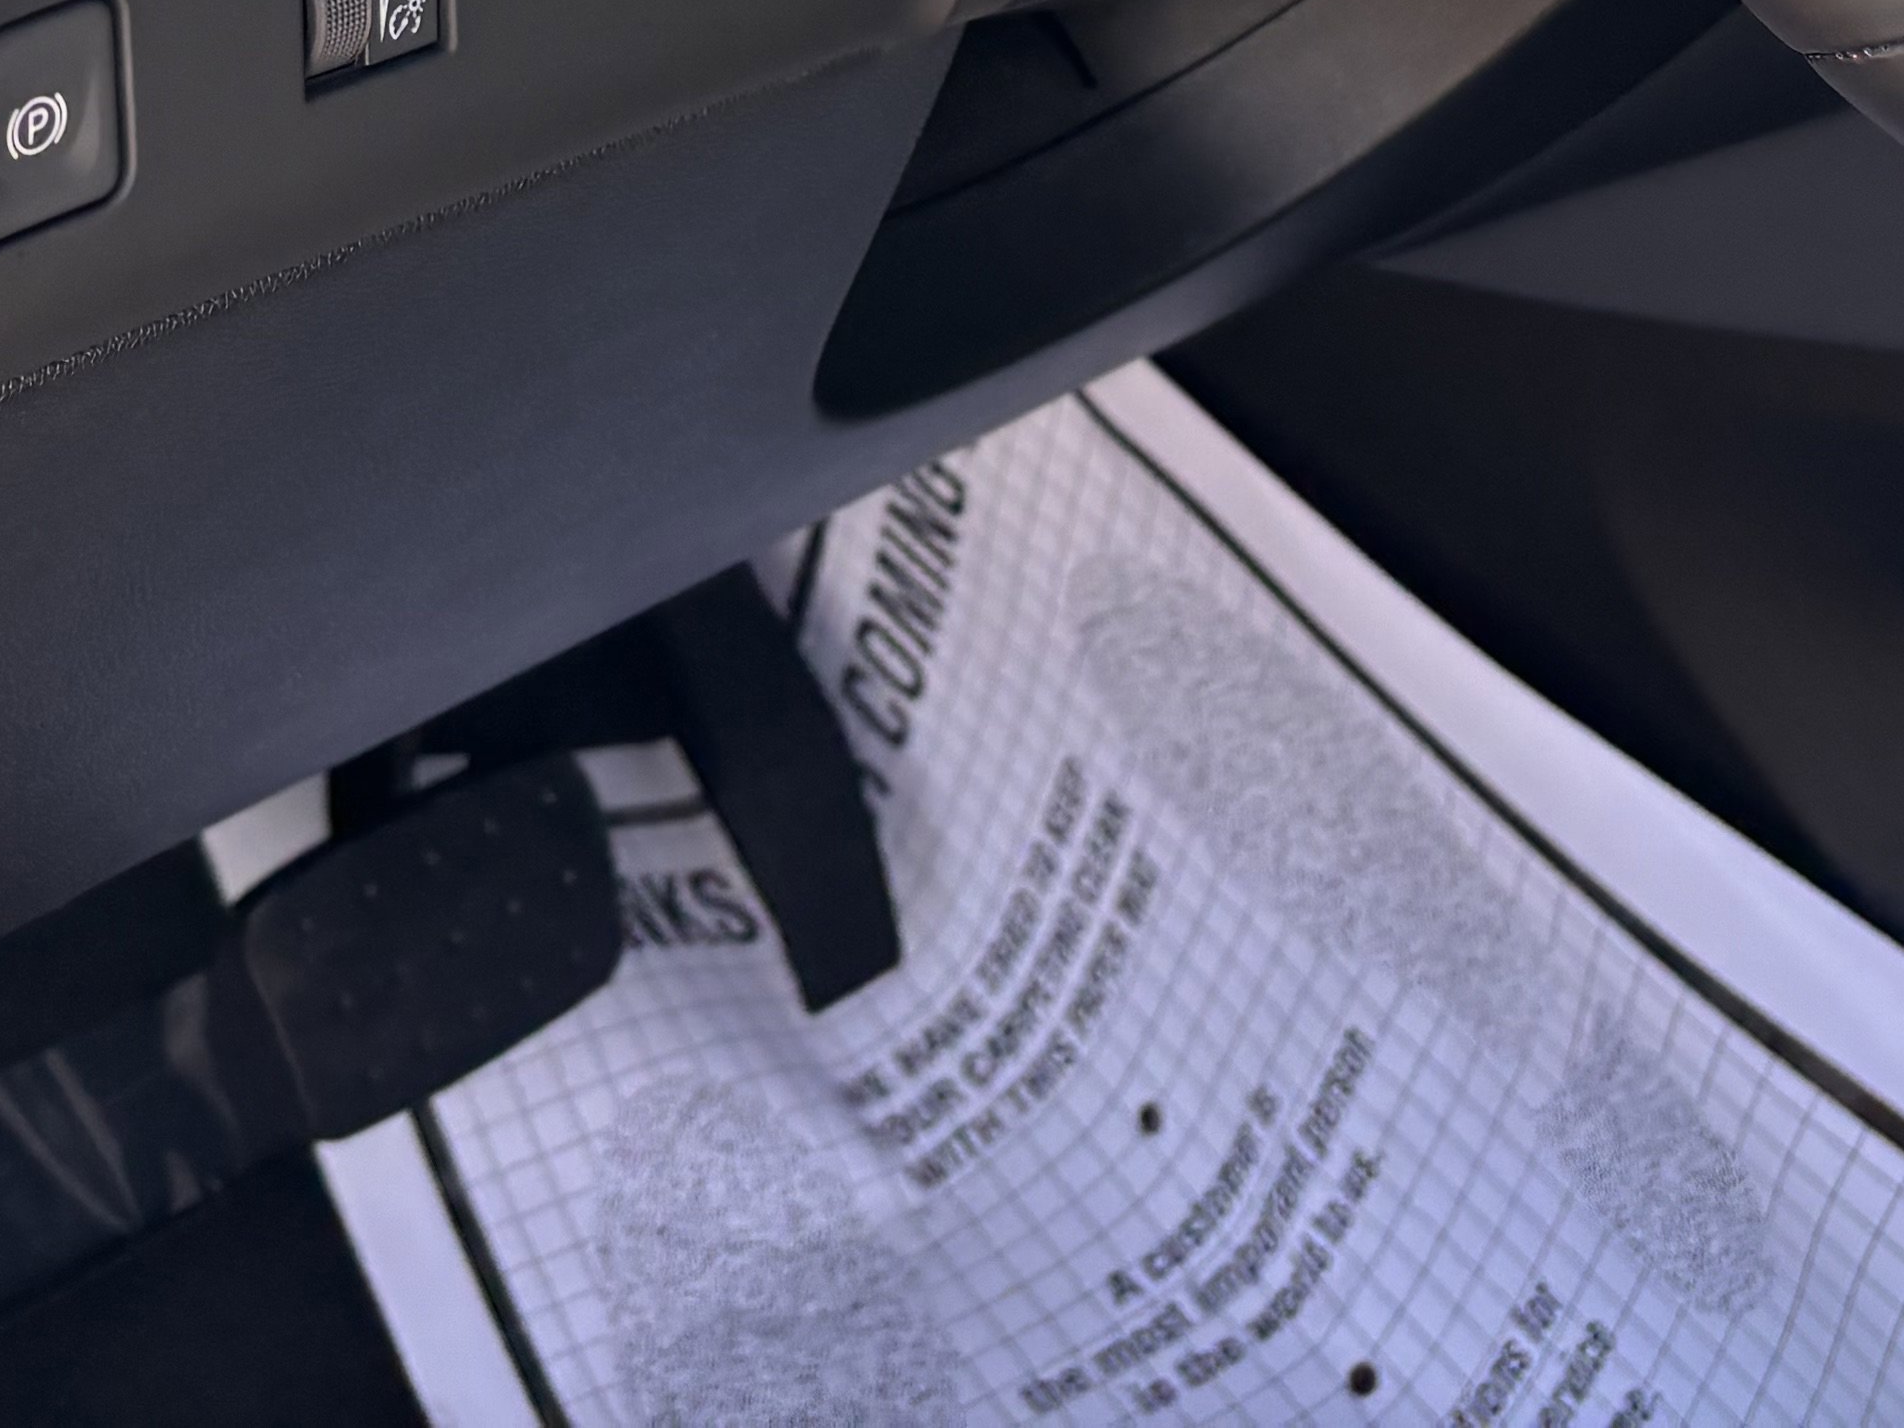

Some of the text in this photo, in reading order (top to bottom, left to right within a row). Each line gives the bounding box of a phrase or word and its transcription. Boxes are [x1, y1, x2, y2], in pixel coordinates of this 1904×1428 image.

[27, 106, 50, 146] P
[840, 455, 966, 751] COMING
[617, 867, 760, 949] NKS
[902, 1107, 1002, 1189] WITH
[1021, 1026, 1376, 1415] the most important person
[1108, 1268, 1143, 1305] A
[1141, 1121, 1260, 1282] customer
[1248, 1235, 1333, 1341] world
[1508, 1281, 1563, 1343] for
